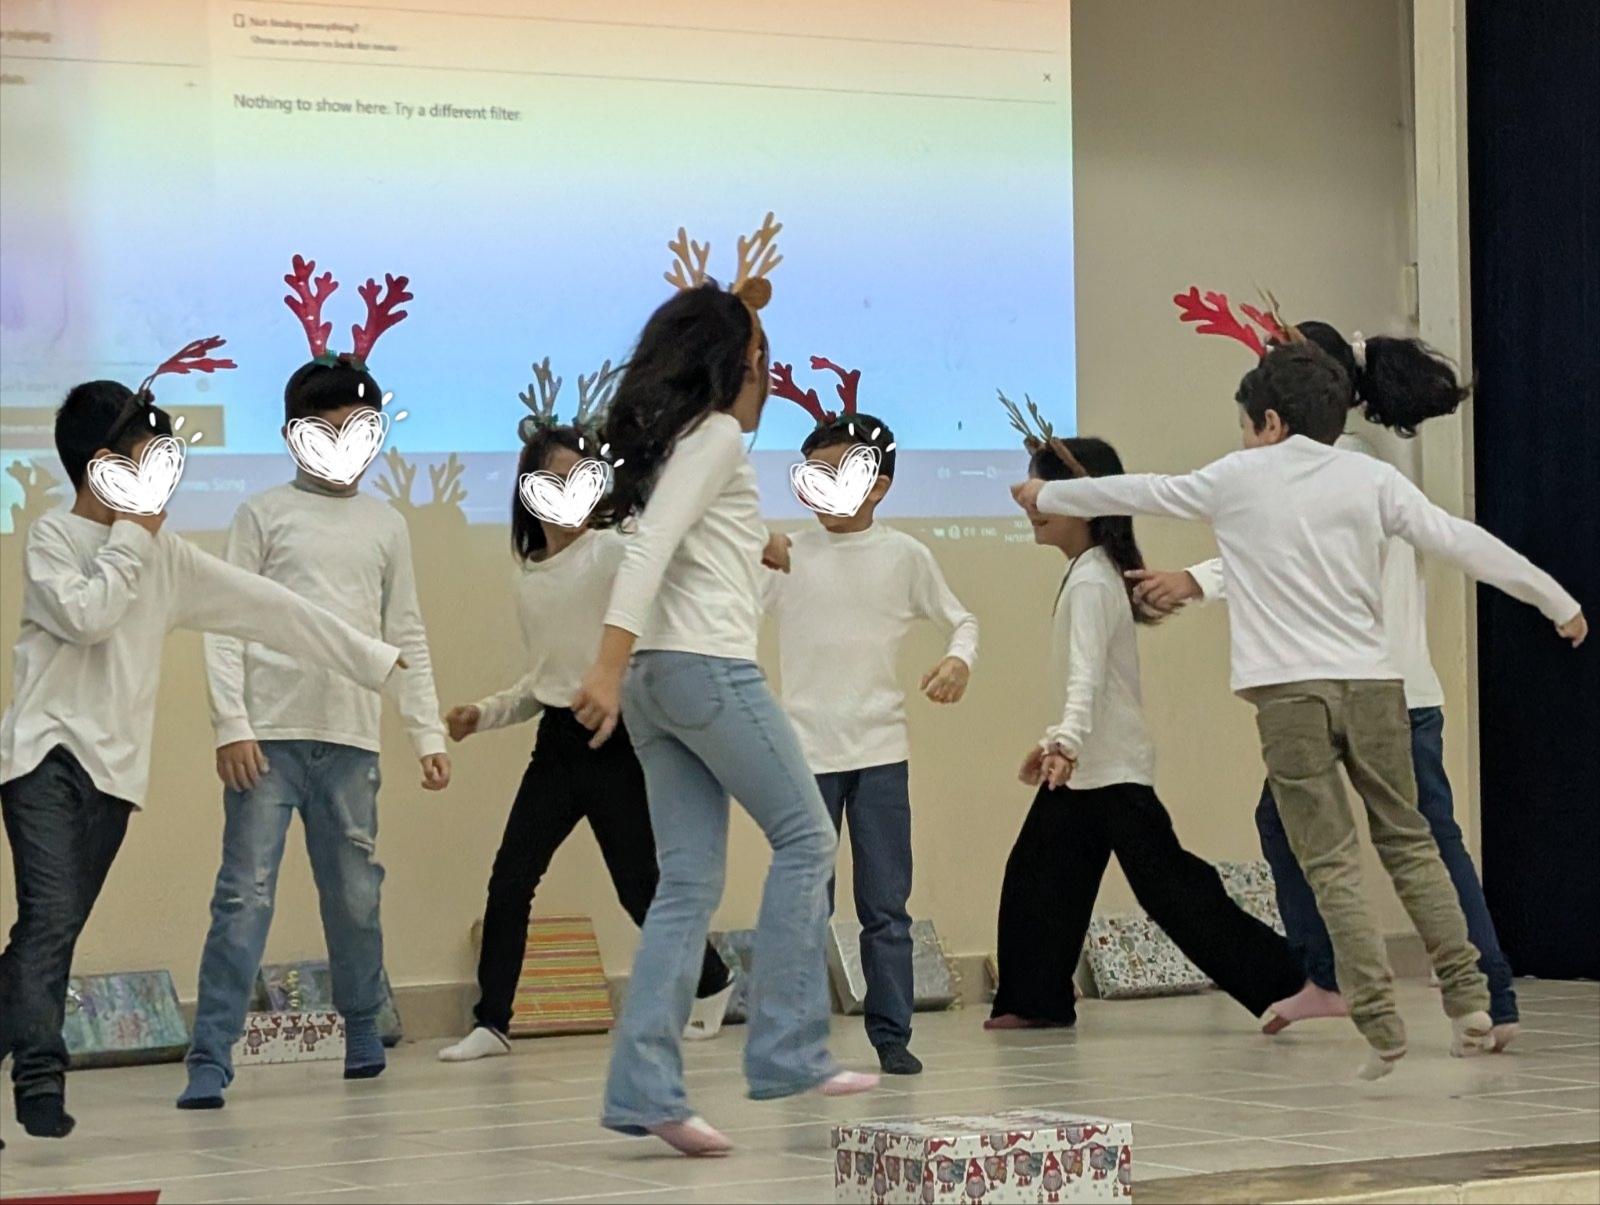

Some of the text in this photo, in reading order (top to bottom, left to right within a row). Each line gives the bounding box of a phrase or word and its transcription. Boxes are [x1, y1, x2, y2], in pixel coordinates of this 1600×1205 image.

[233, 94, 292, 114] Nothing
[296, 99, 312, 112] to
[316, 98, 352, 114] show
[356, 99, 390, 115] here.
[394, 102, 414, 120] Try
[418, 106, 426, 117] a
[429, 103, 487, 120] different
